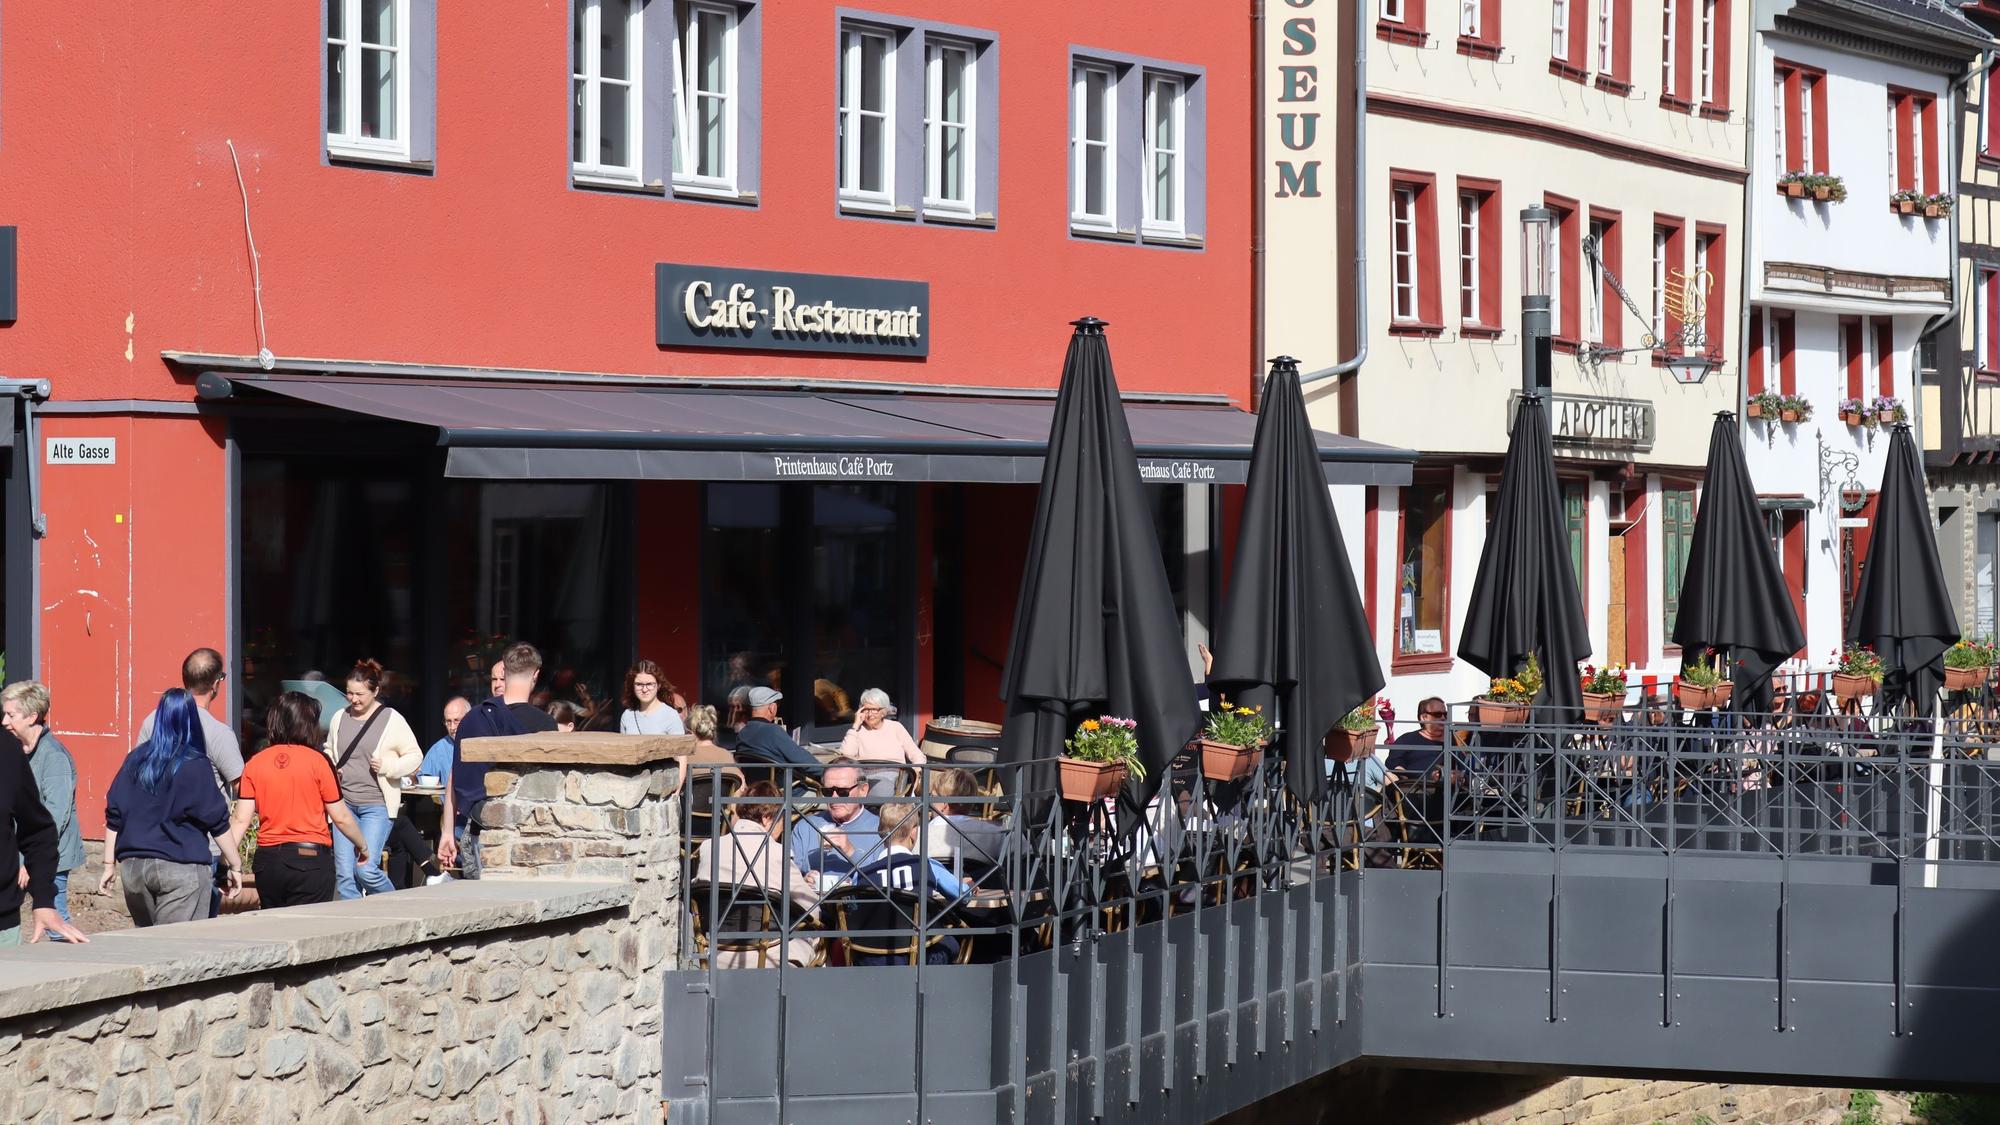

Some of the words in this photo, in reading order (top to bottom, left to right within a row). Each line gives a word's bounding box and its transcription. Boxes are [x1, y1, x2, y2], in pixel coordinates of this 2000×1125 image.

[1275, 0, 1321, 198] SEUM
[1559, 401, 1650, 440] APOTHEKE
[53, 443, 74, 459] Alte
[79, 443, 110, 459] Gasse
[774, 456, 838, 476] Printenhaus
[839, 457, 864, 476] Café
[866, 457, 894, 476] Portz
[1171, 462, 1192, 479] Café
[1193, 462, 1216, 479] Portz
[876, 865, 914, 891] 10
